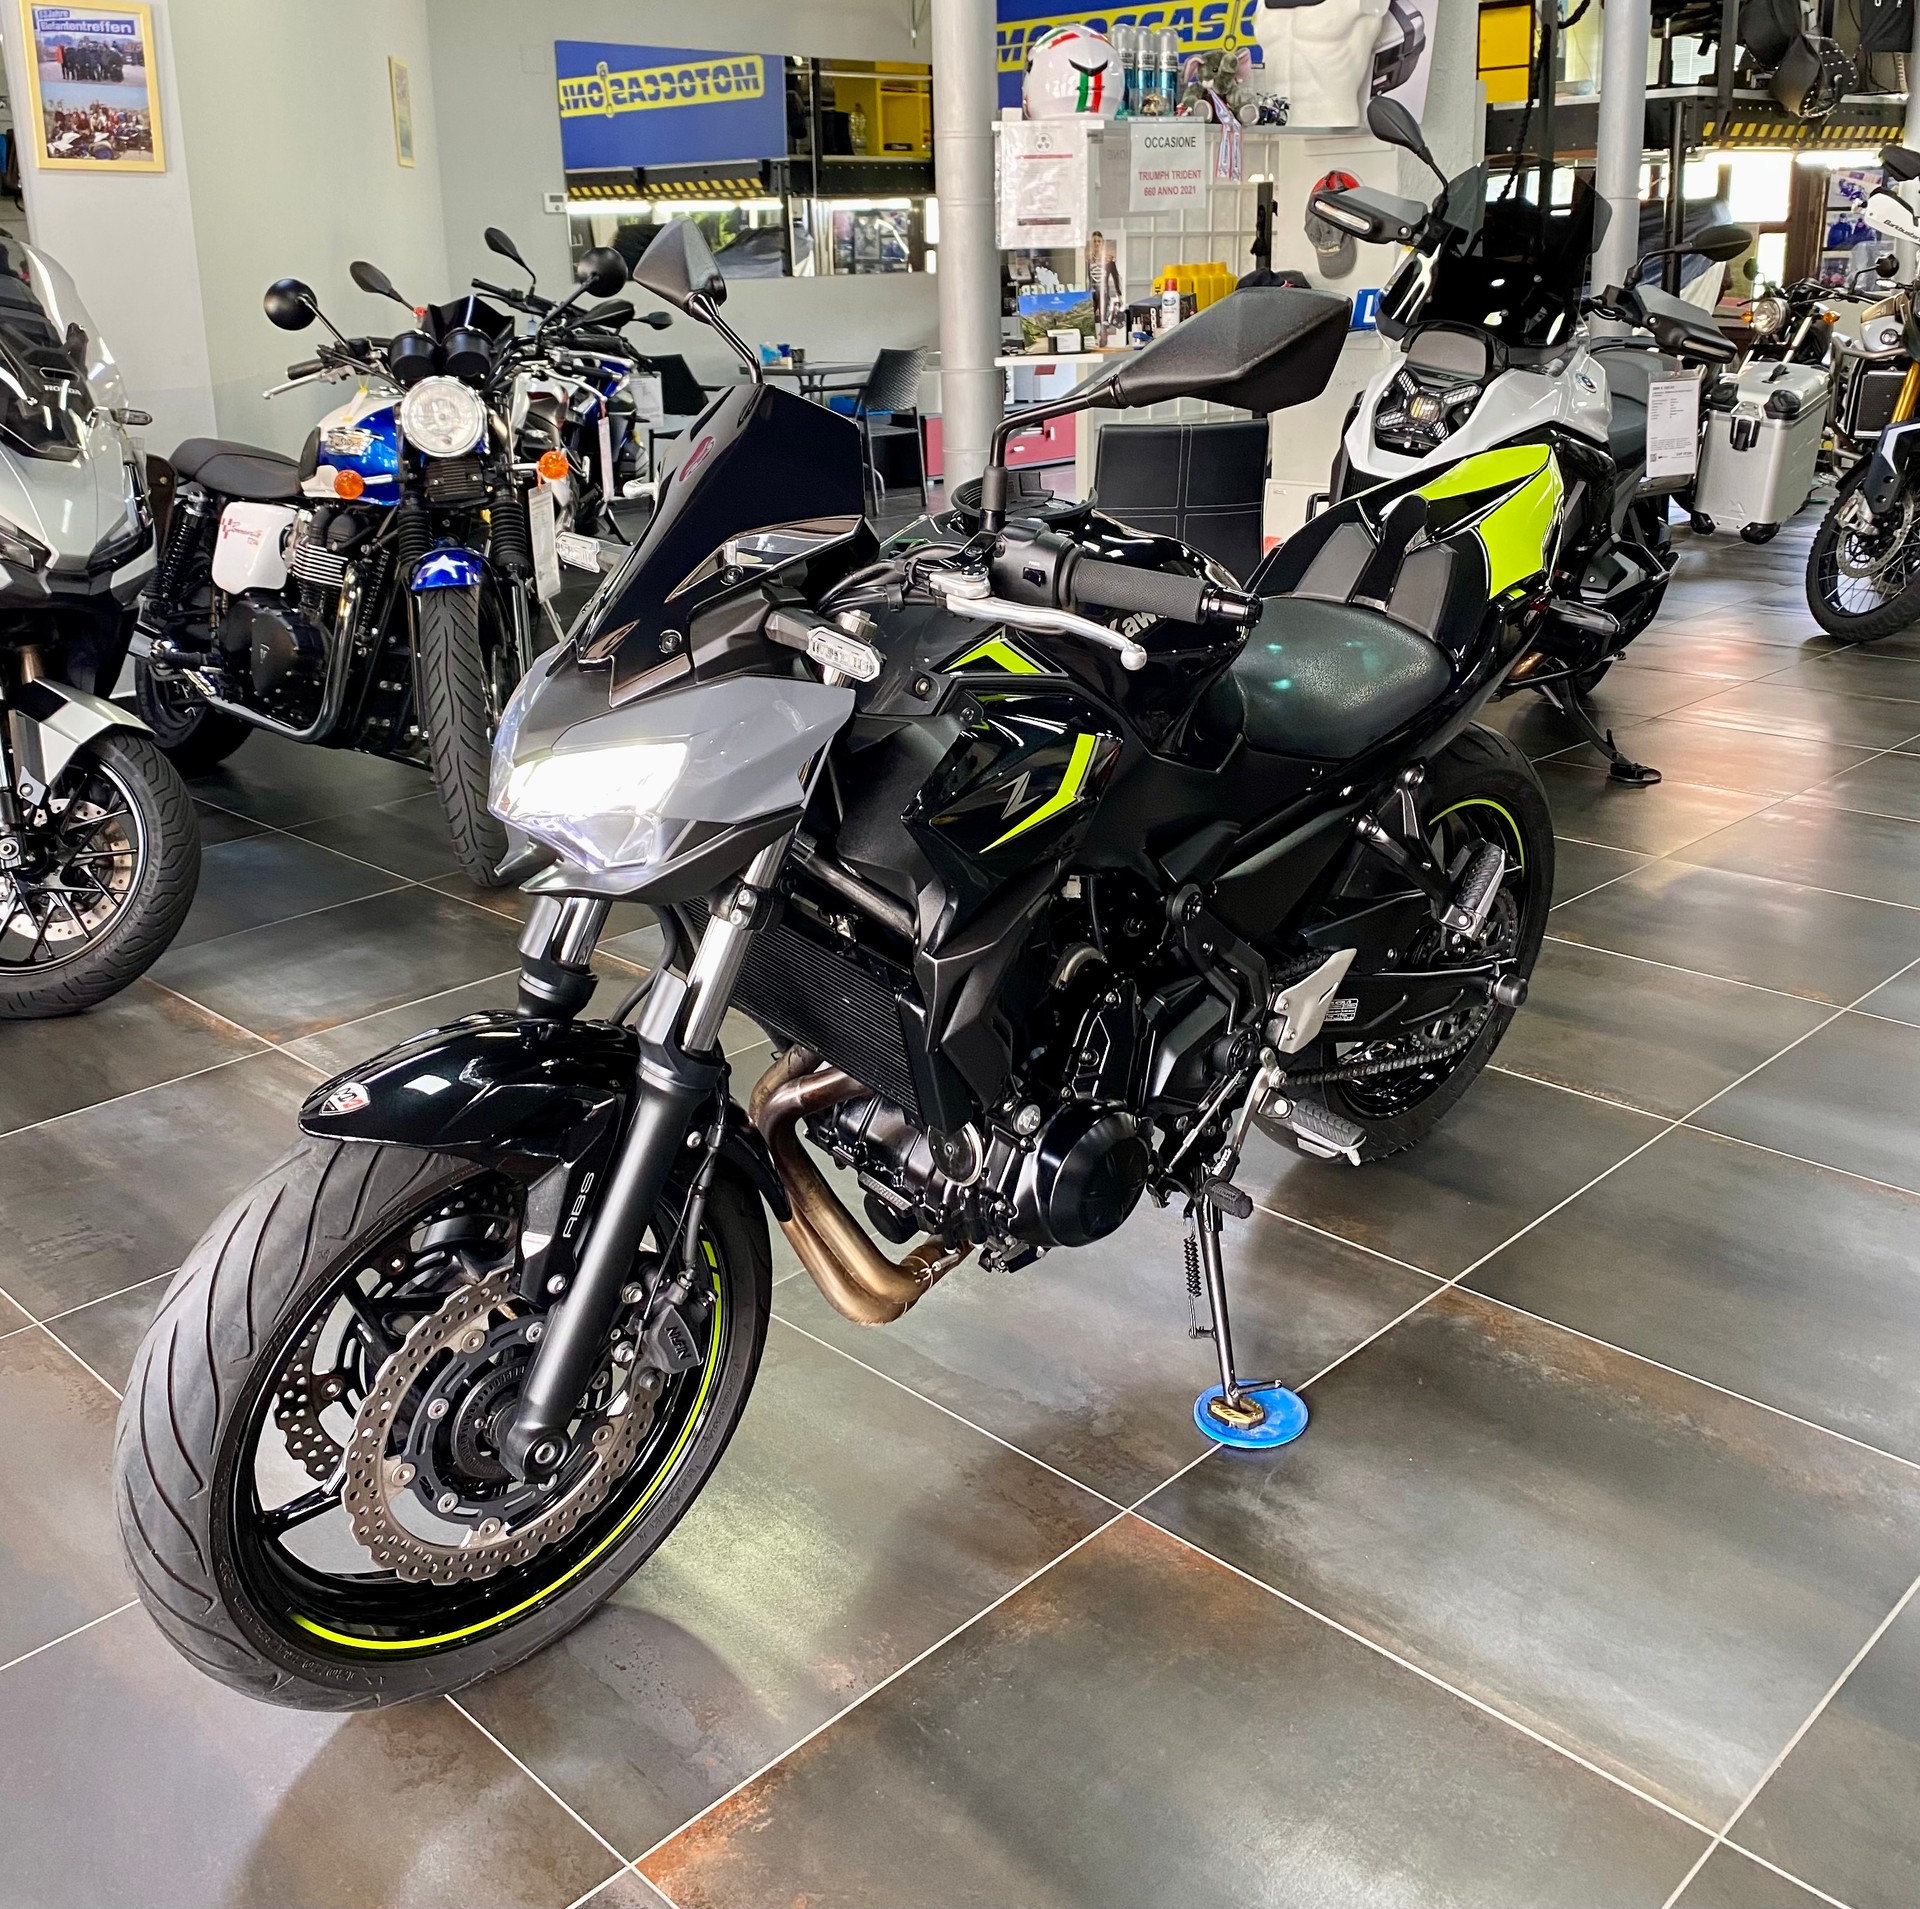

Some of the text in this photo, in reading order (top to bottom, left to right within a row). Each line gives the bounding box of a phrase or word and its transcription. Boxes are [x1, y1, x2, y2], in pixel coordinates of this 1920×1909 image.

[1144, 136, 1196, 148] OCCASIONE
[1139, 169, 1202, 181] TRIUMPH TRIDENT
[1144, 185, 1196, 197] 660 ANNO 2021
[562, 1171, 595, 1238] ABS
